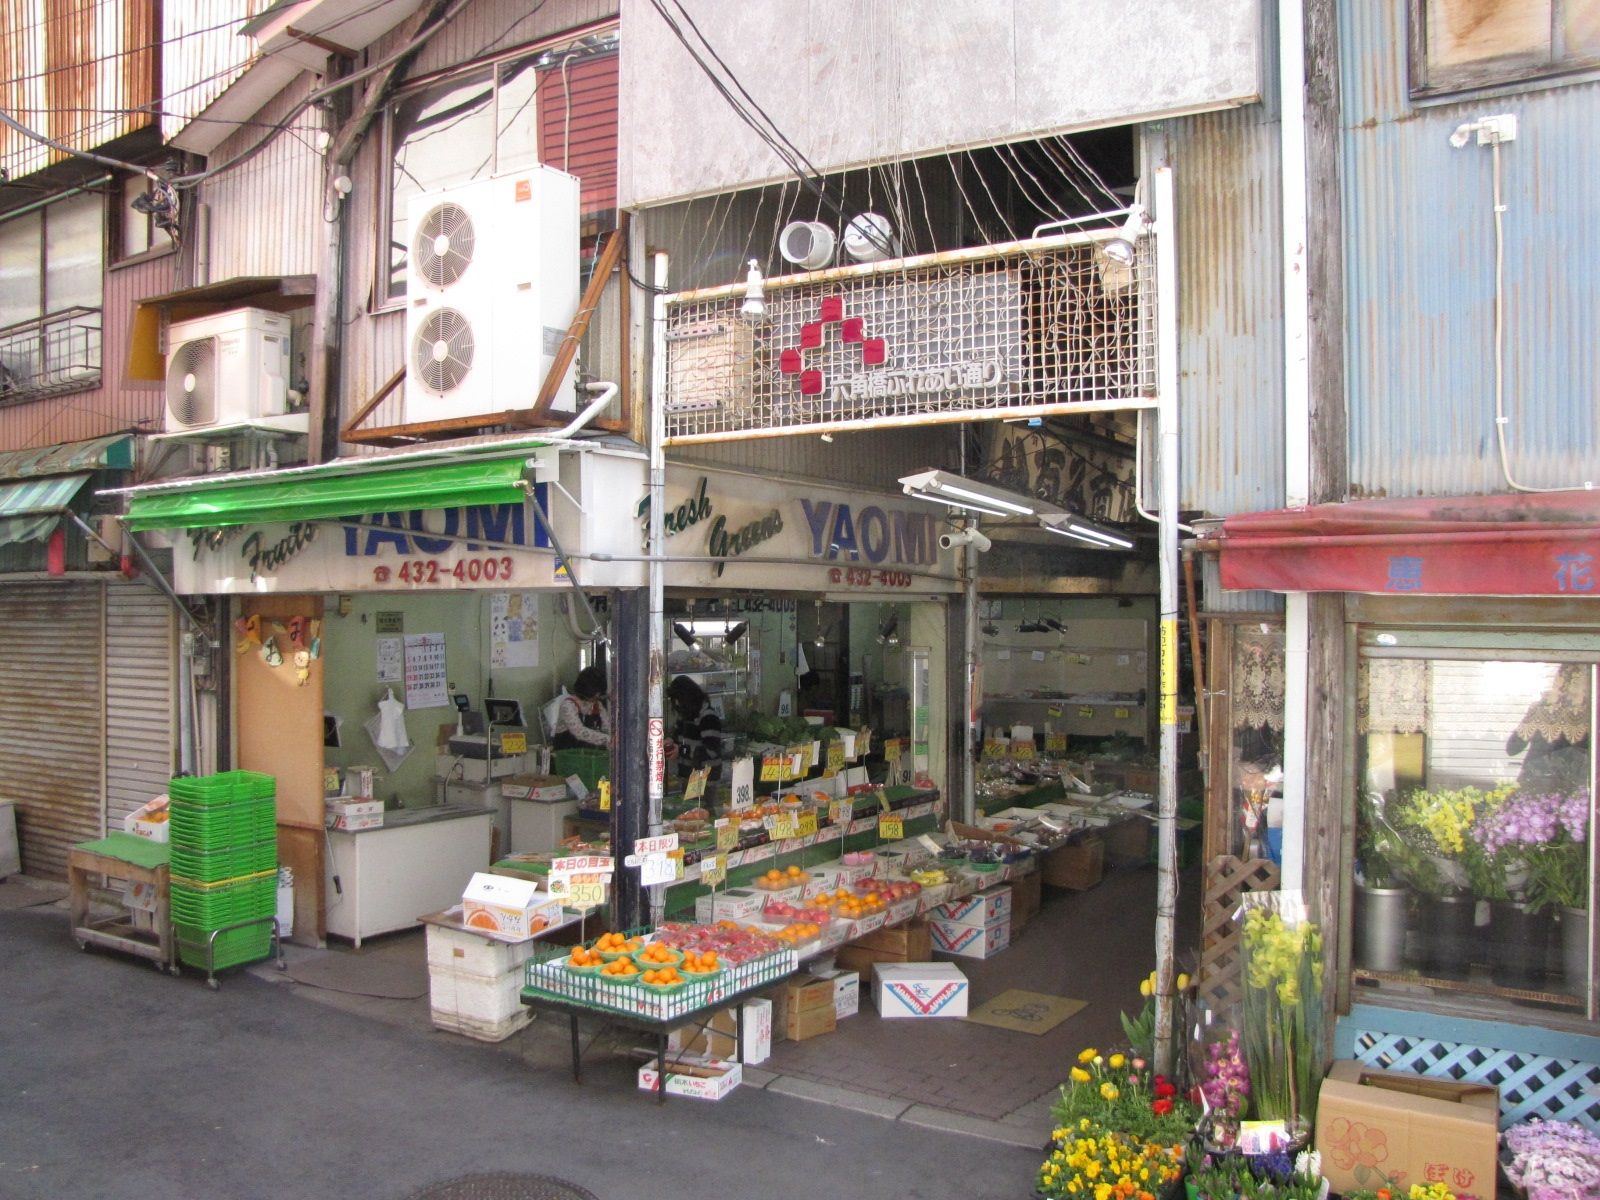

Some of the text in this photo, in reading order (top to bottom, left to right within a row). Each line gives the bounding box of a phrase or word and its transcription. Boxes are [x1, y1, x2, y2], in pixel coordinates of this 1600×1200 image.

[831, 360, 1002, 402] 六角橋ふれあい通り
[705, 509, 784, 578] Greens
[800, 498, 938, 565] YAOMI
[242, 522, 319, 583] Fruits
[399, 556, 514, 583] 432-4003
[847, 567, 912, 588] 432-4003
[1552, 552, 1596, 592] 花
[767, 766, 792, 779] 40
[638, 837, 674, 853] 本日限り
[554, 856, 609, 872] 本日の目玉
[571, 884, 602, 902] 350
